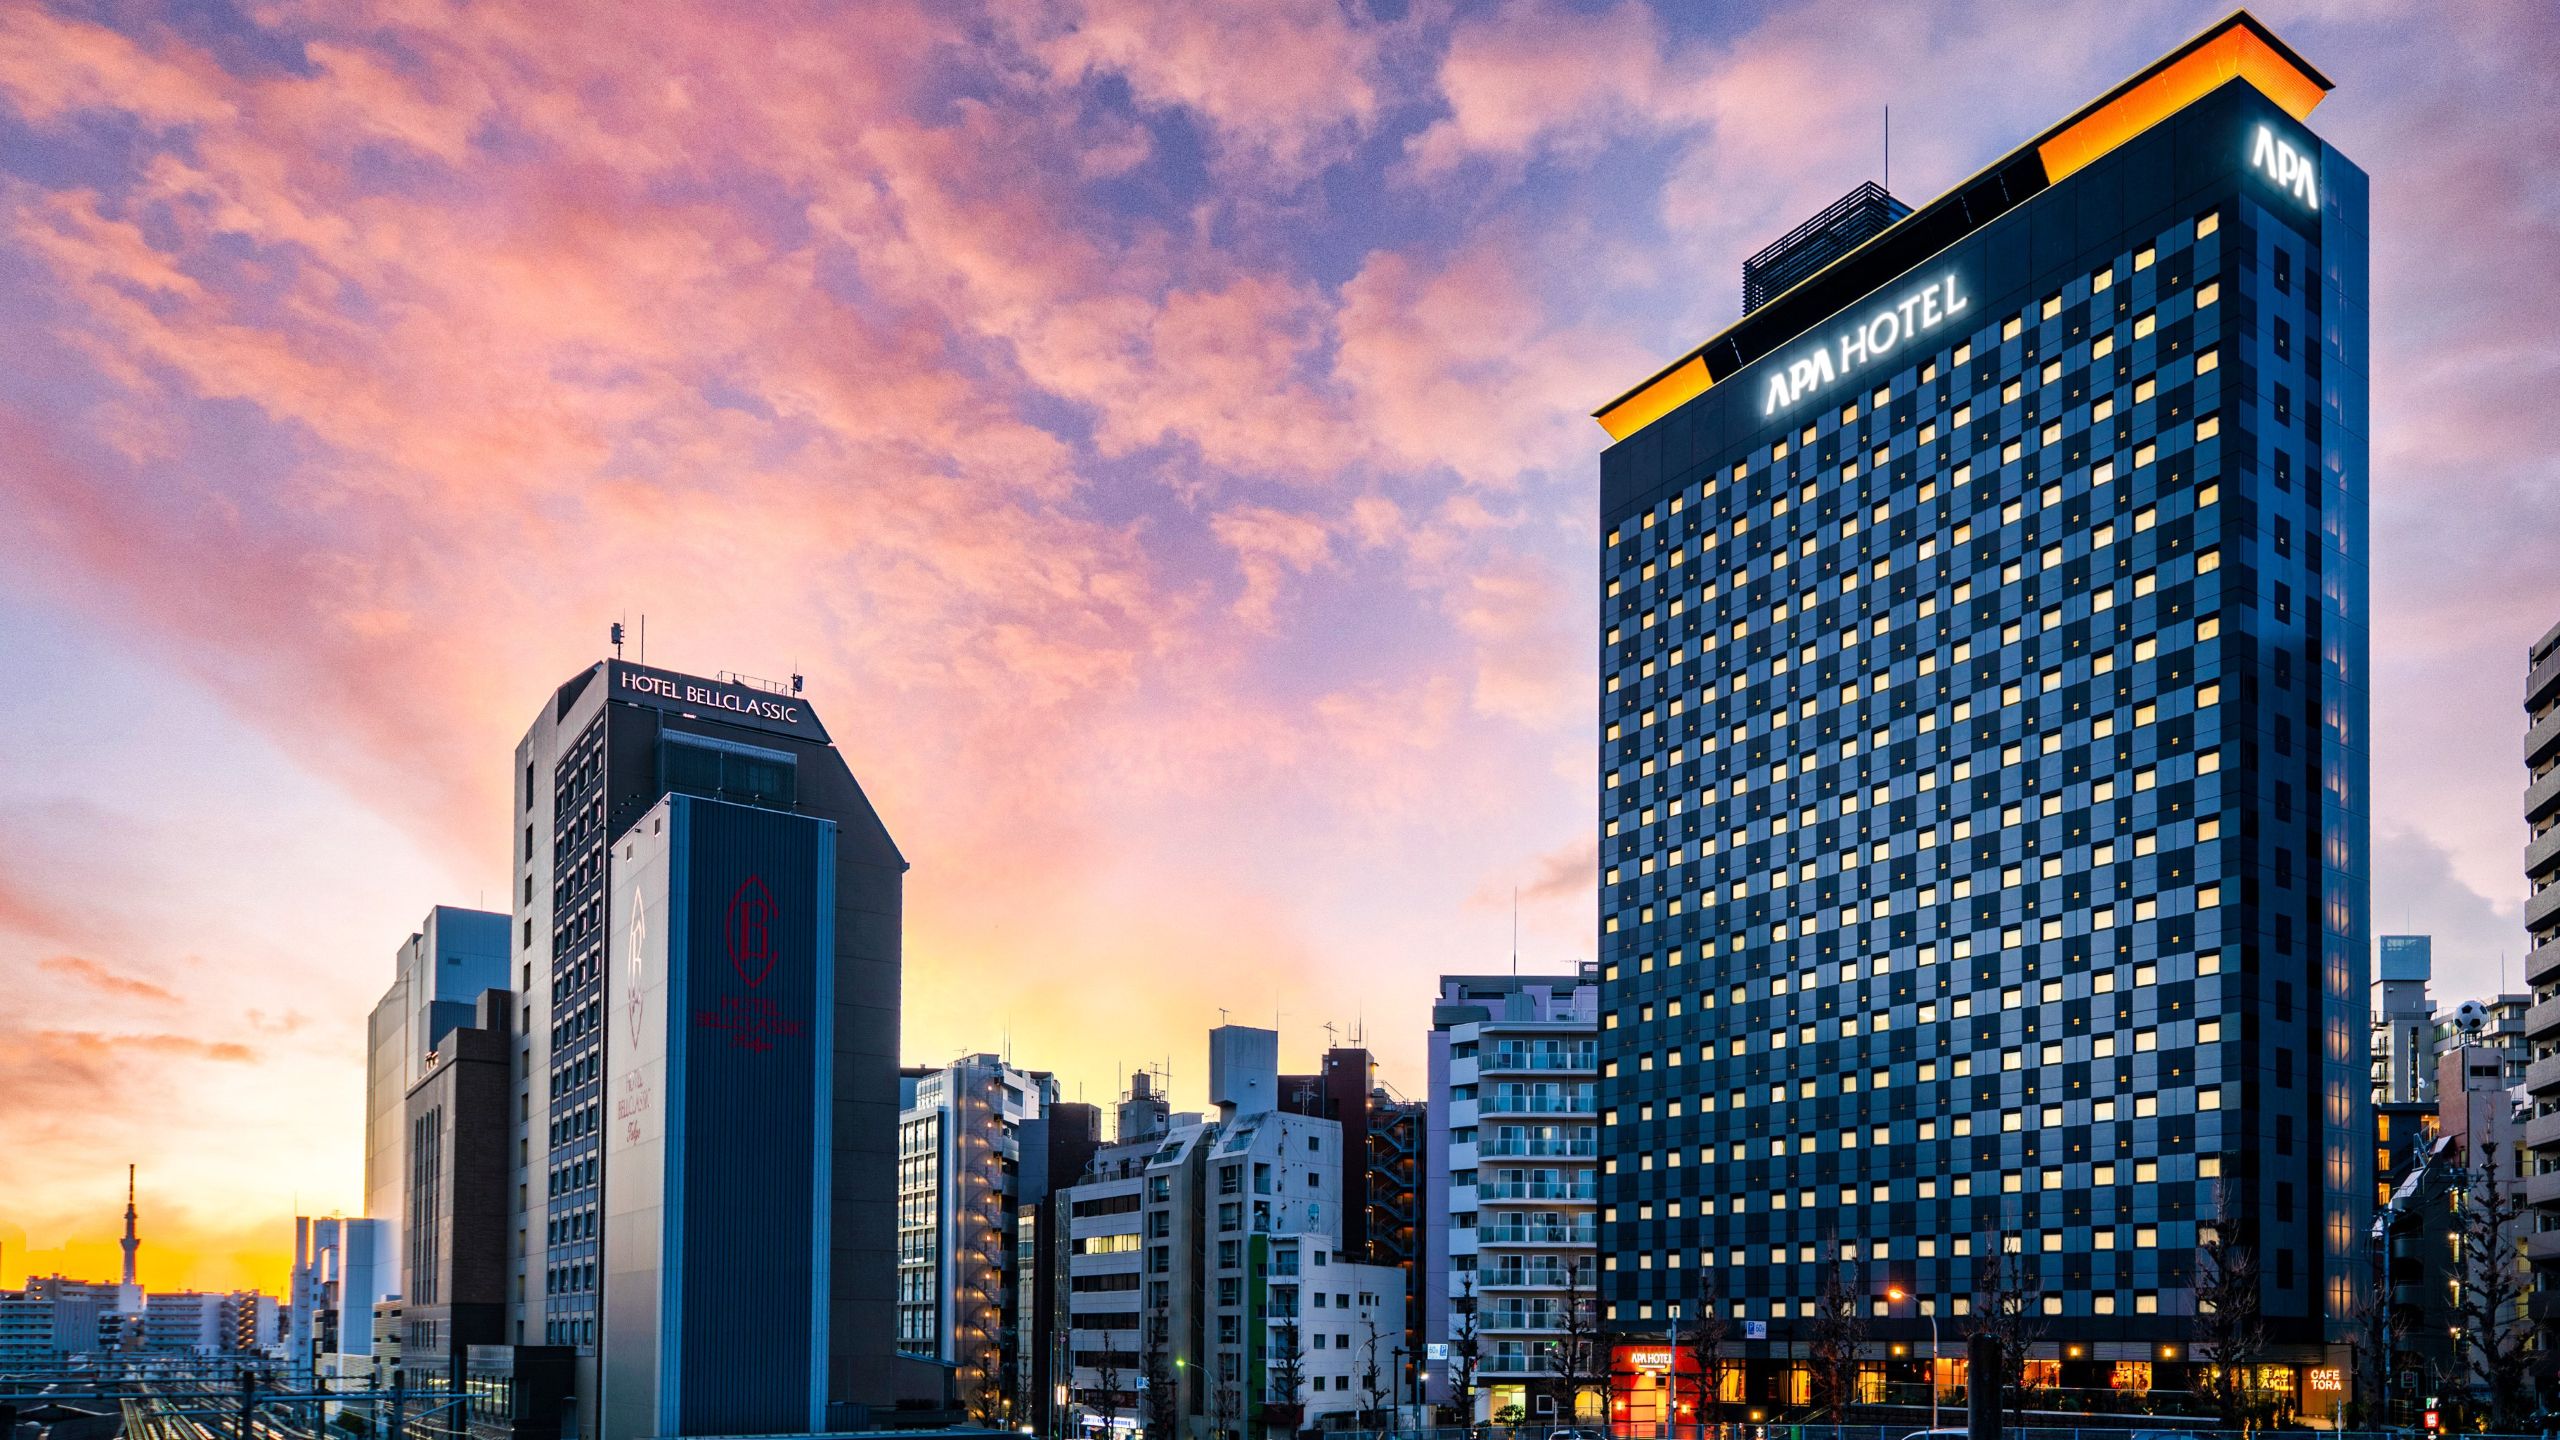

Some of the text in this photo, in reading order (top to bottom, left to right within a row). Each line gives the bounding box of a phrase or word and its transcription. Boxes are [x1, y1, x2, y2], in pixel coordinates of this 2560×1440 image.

[2253, 125, 2318, 210] APA
[1766, 274, 1967, 415] APA HOTEL
[621, 671, 798, 723] HOTEL BELLCLASSIC
[1631, 1353, 1672, 1364] APA HOTEL
[2311, 1369, 2340, 1380] CAFE
[2311, 1380, 2341, 1391] TORA
